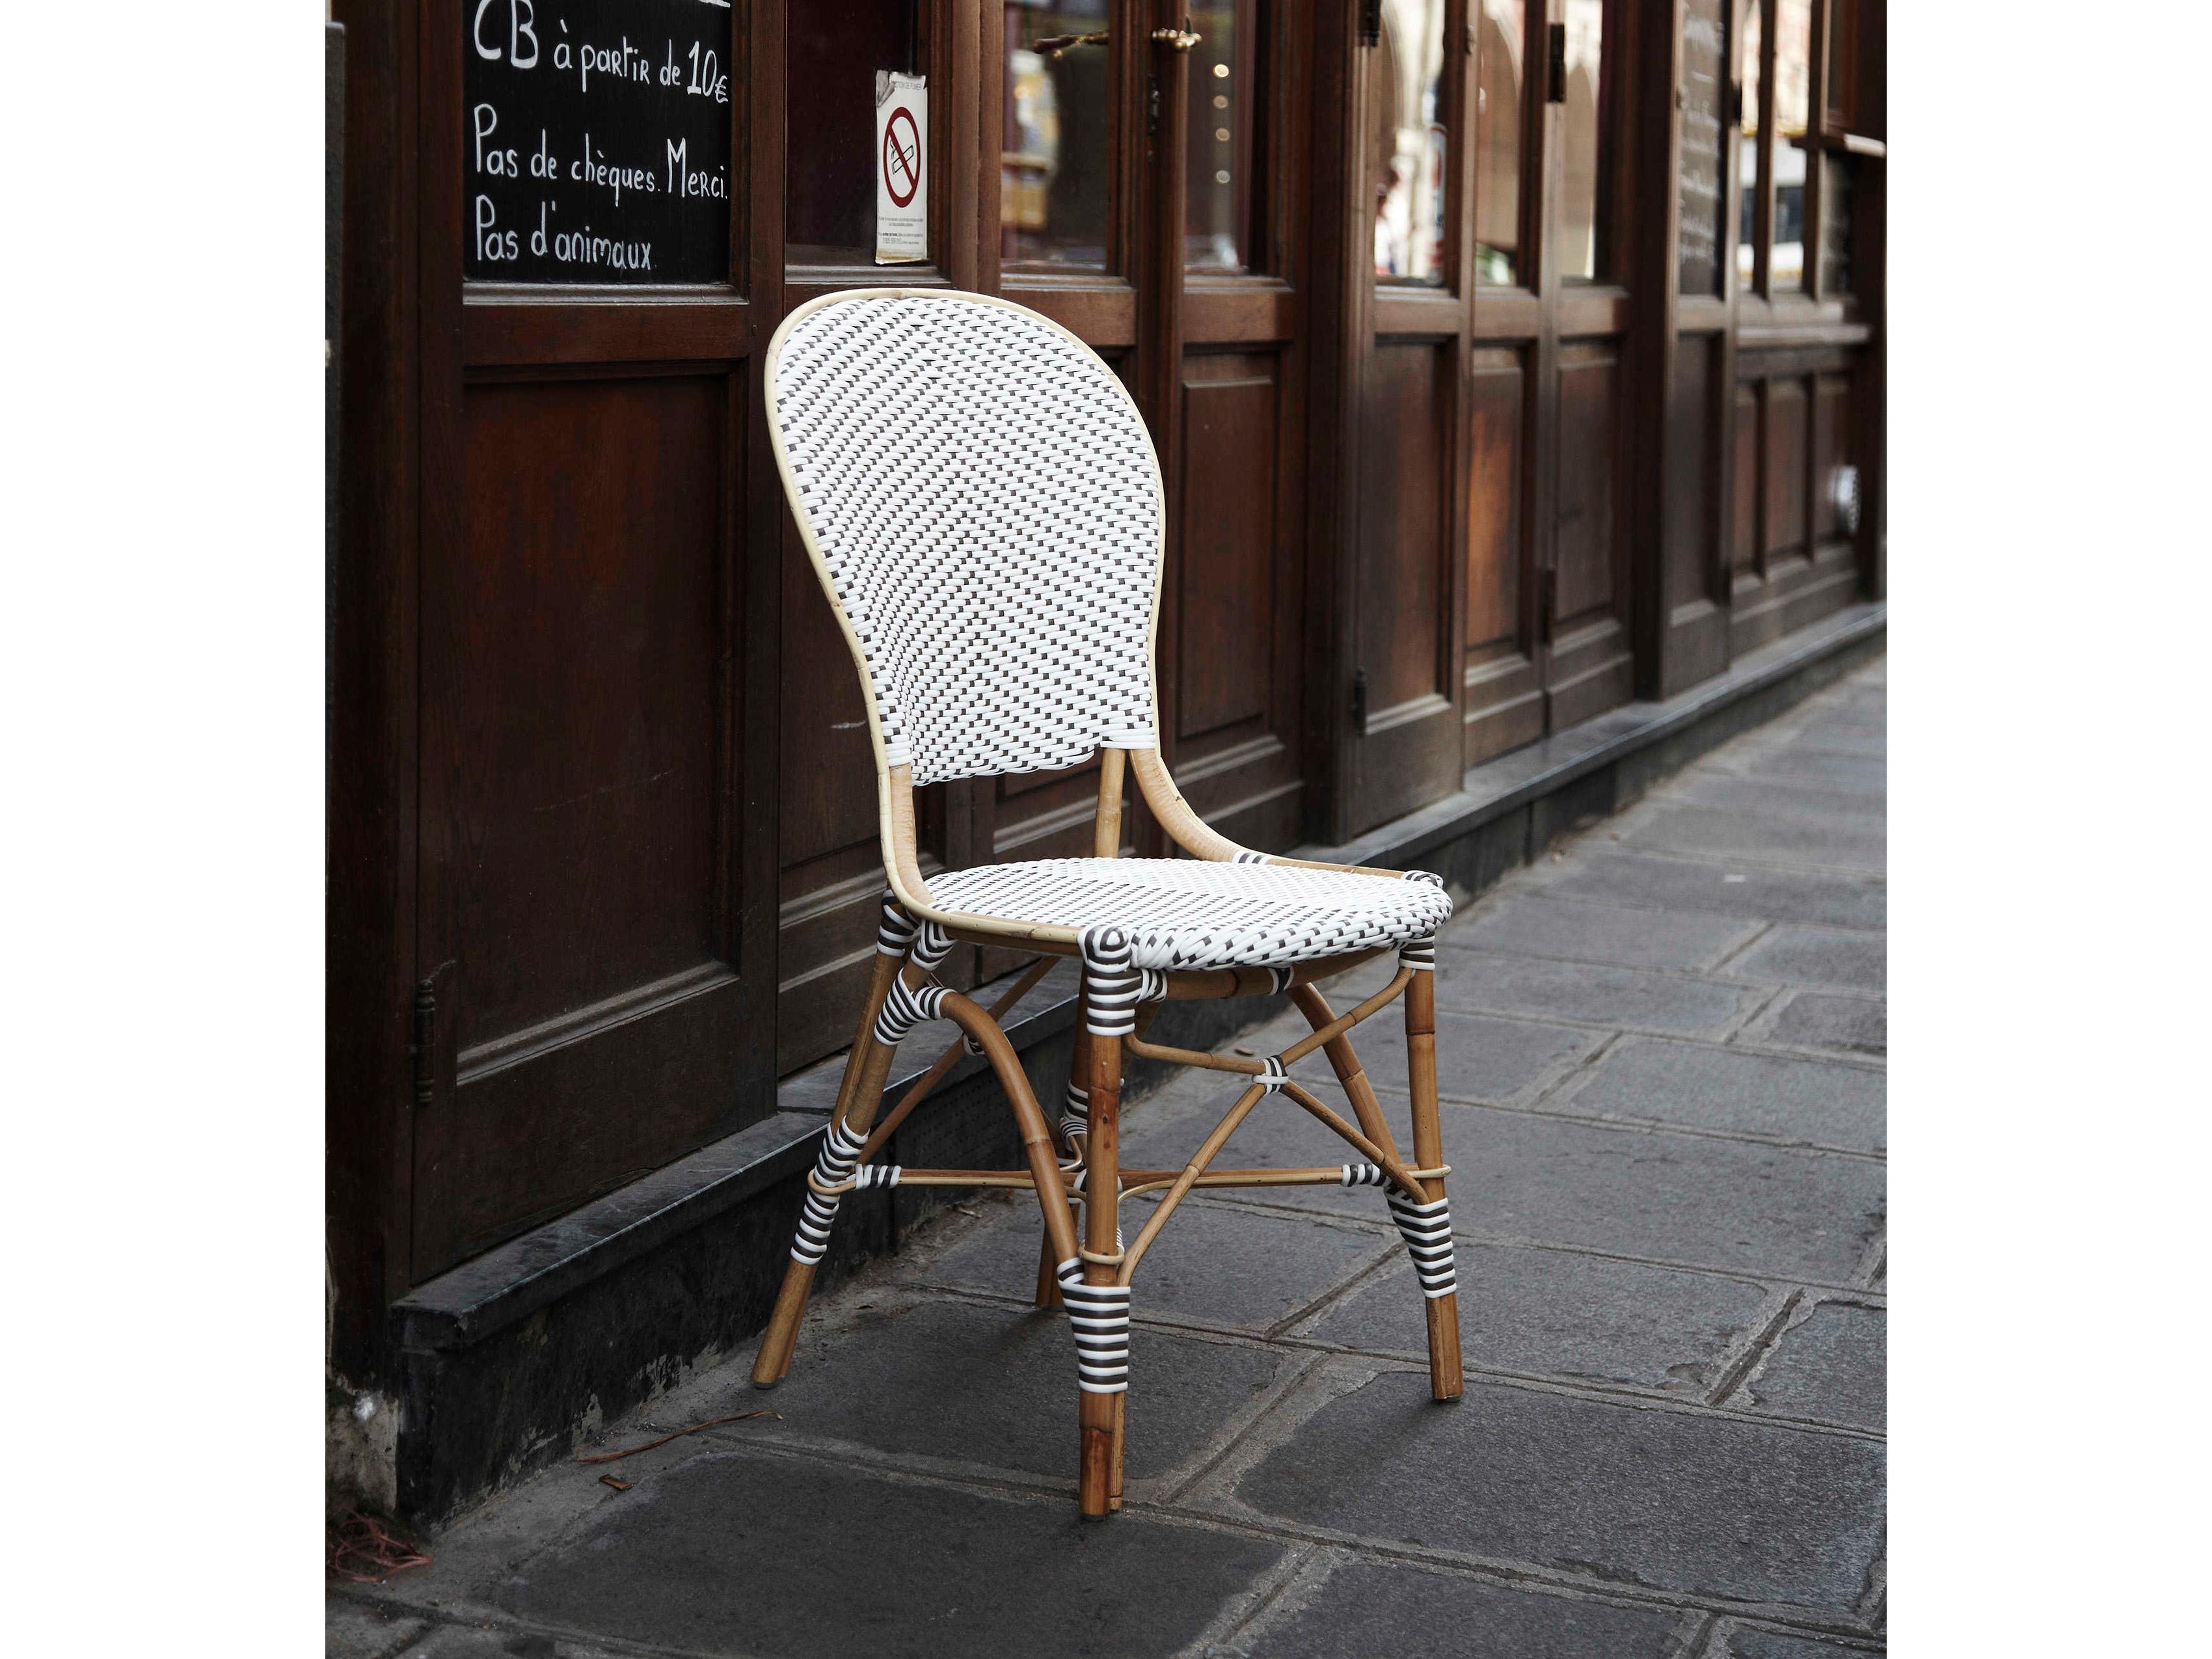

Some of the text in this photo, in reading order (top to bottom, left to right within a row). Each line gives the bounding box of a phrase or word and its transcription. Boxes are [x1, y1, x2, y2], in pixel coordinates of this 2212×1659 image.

[474, 0, 539, 69] CB
[554, 18, 573, 70] à
[659, 38, 681, 87] de
[686, 40, 729, 103] 10€
[474, 103, 519, 178] Pas
[530, 128, 558, 180] de
[571, 133, 661, 208] chèques.
[476, 194, 519, 261] Pas
